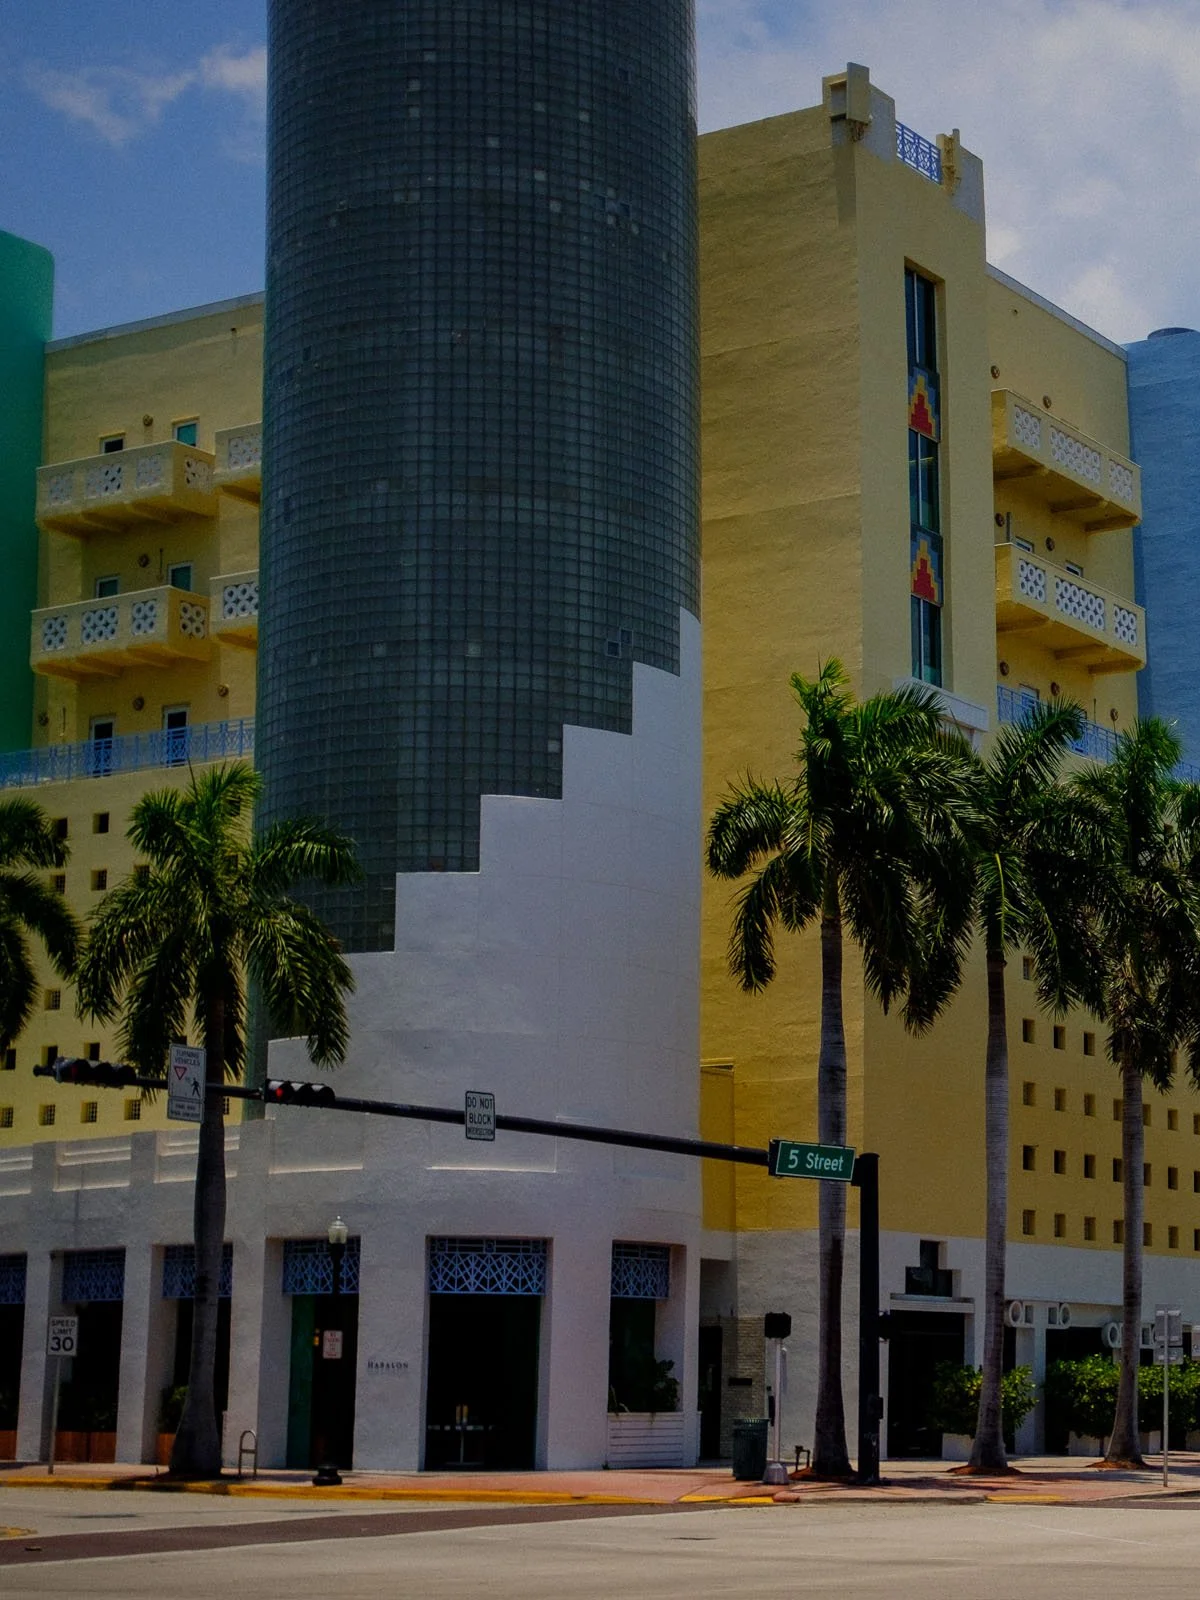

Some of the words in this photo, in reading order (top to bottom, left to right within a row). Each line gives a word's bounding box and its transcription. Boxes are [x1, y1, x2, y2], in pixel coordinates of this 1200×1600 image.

[467, 1096, 476, 1108] DO
[479, 1097, 493, 1110] NOT
[468, 1112, 492, 1125] BLOCK
[787, 1148, 800, 1169] 5
[805, 1152, 845, 1172] Street
[51, 1319, 76, 1327] SPEED
[52, 1327, 73, 1335] LIMIT
[50, 1336, 74, 1352] 30
